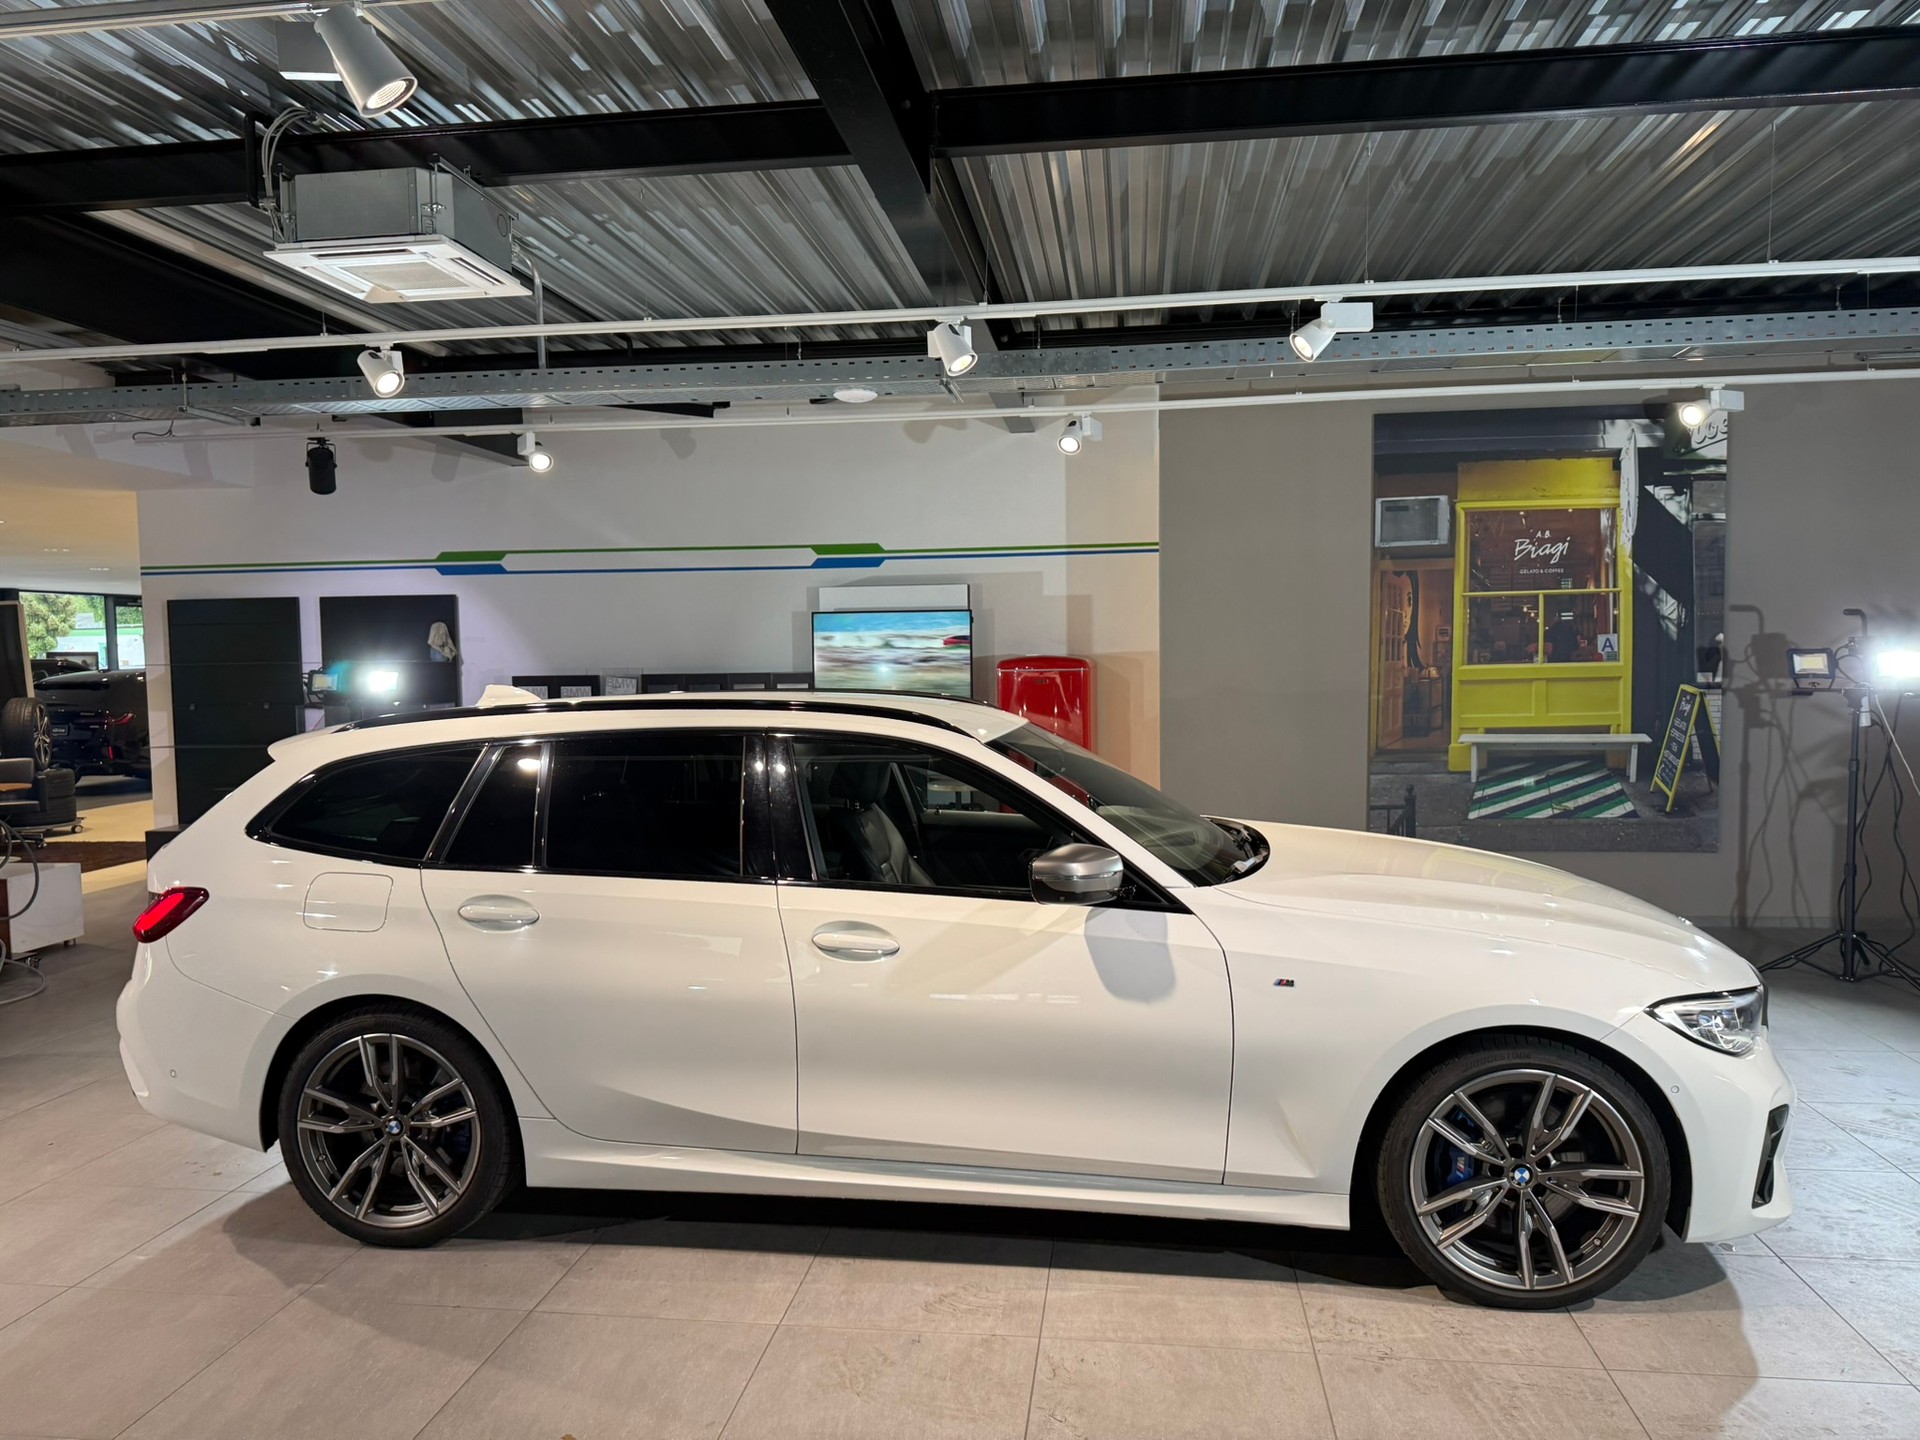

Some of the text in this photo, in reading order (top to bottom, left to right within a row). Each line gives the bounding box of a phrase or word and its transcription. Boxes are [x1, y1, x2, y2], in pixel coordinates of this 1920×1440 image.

[1513, 536, 1571, 565] Biagi
[1601, 637, 1615, 652] A
[607, 677, 635, 689] BMW
[561, 687, 591, 697] BMW
